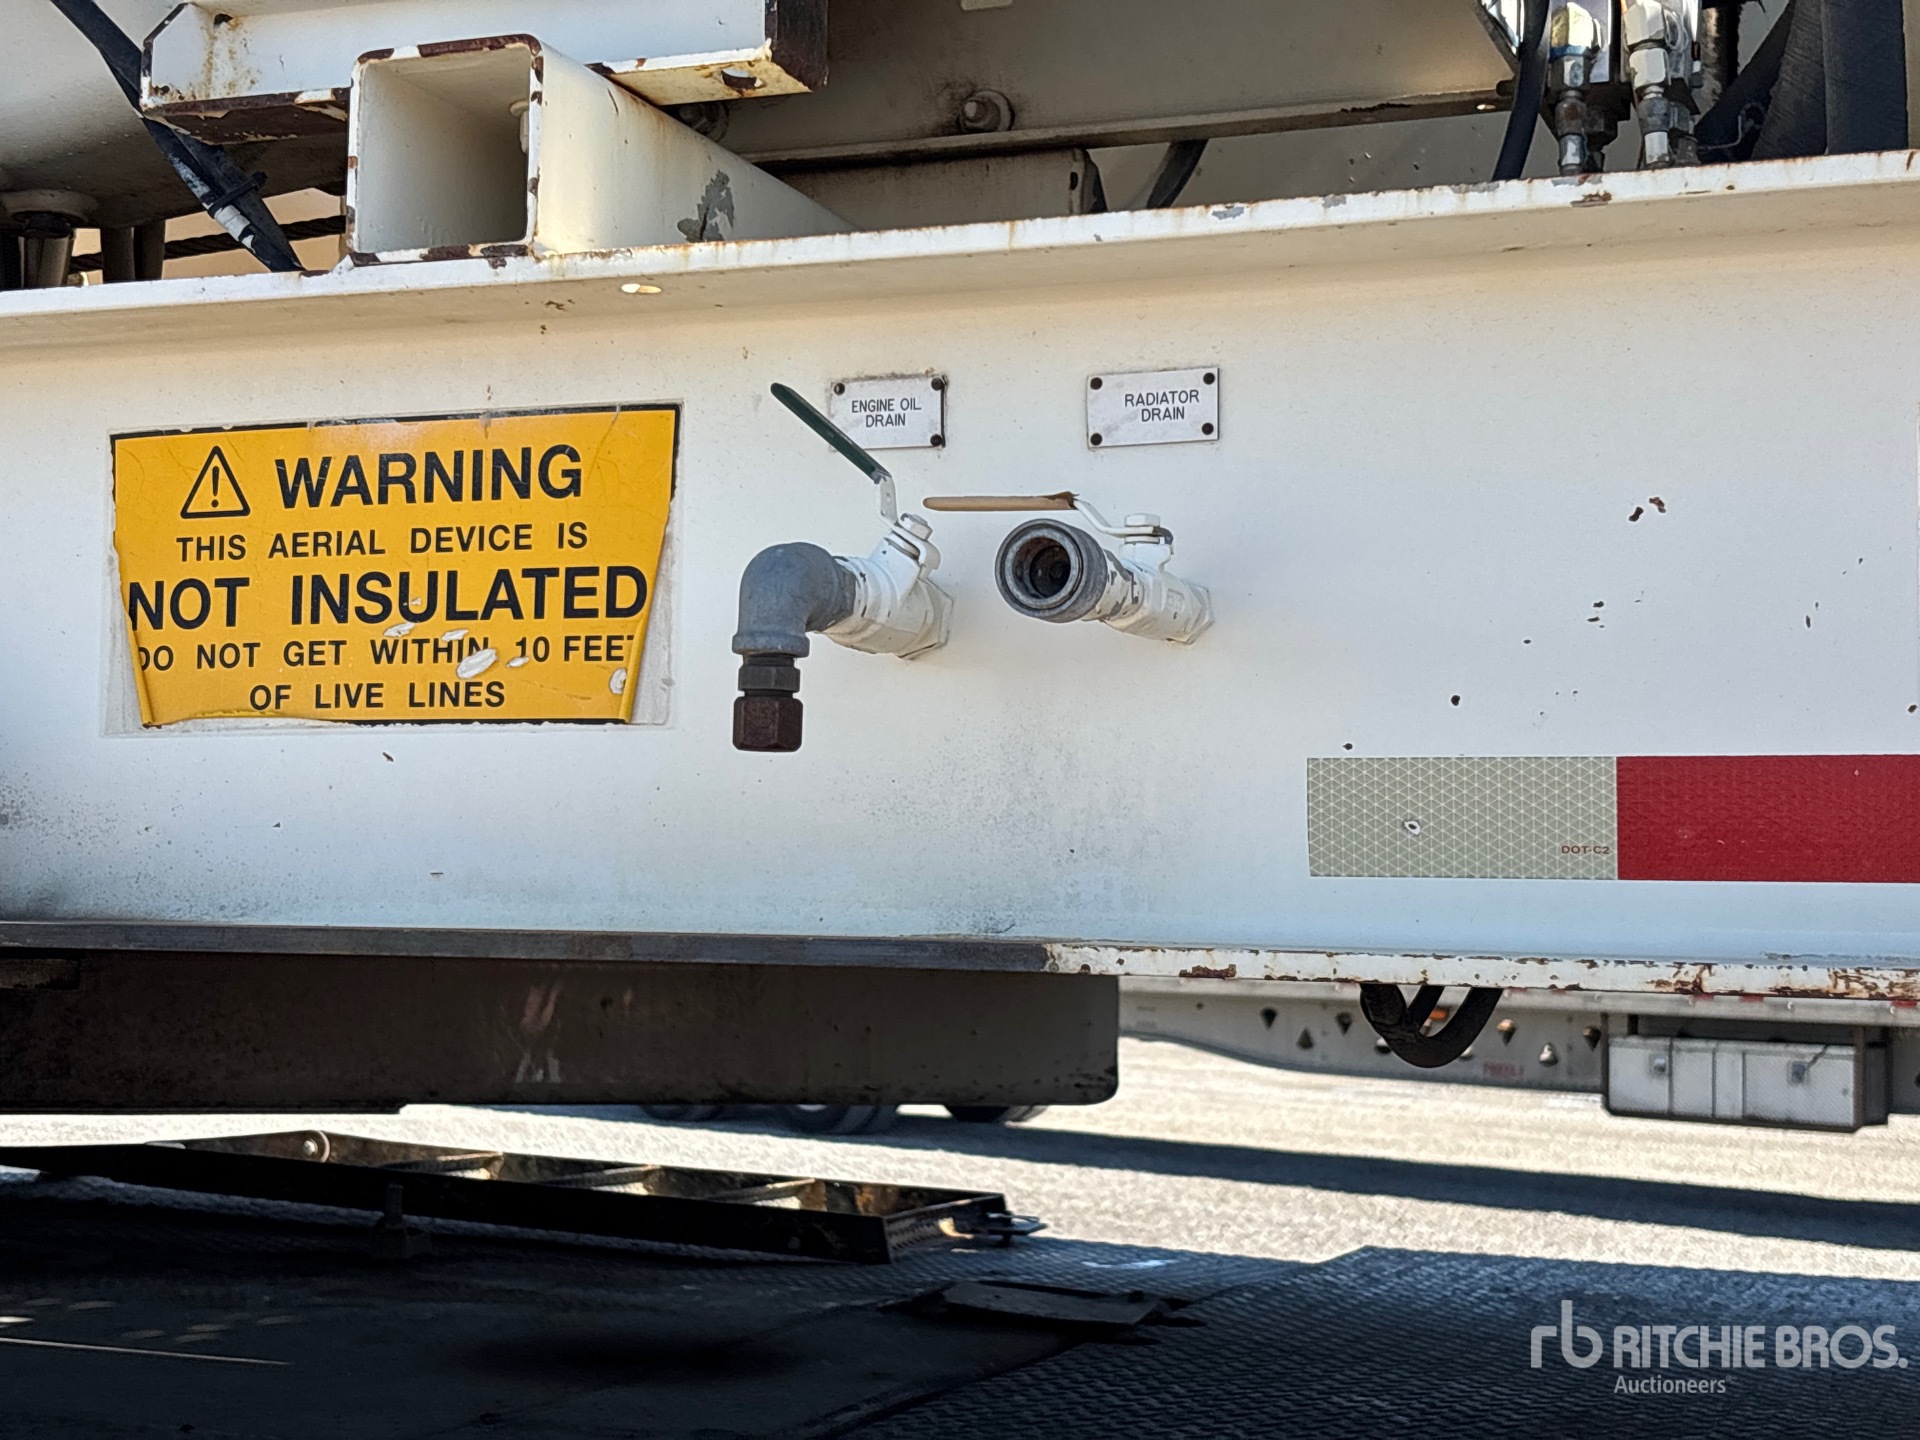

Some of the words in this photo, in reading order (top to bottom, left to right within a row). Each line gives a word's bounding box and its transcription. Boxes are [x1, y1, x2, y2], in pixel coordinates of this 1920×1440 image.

[851, 398, 895, 413] ENGINE
[900, 397, 922, 411] OIL
[1124, 389, 1200, 407] RADIATOR
[865, 413, 906, 428] DRAIN
[1141, 406, 1185, 422] DRAIN
[274, 444, 582, 509] WARNING
[176, 535, 246, 562] THIS
[268, 530, 386, 559] AERIAL
[410, 524, 532, 554] DEVICE
[558, 521, 588, 549] IS
[128, 577, 250, 632] NOT
[291, 565, 648, 625] INSULATED
[197, 642, 261, 670] NOT
[283, 640, 347, 667] GET
[370, 637, 489, 665] WITHIN
[515, 636, 550, 663] 10
[249, 684, 292, 711] OF
[315, 683, 384, 709] LIVE
[408, 681, 505, 708] LINES
[1561, 845, 1610, 854] DOT-C2
